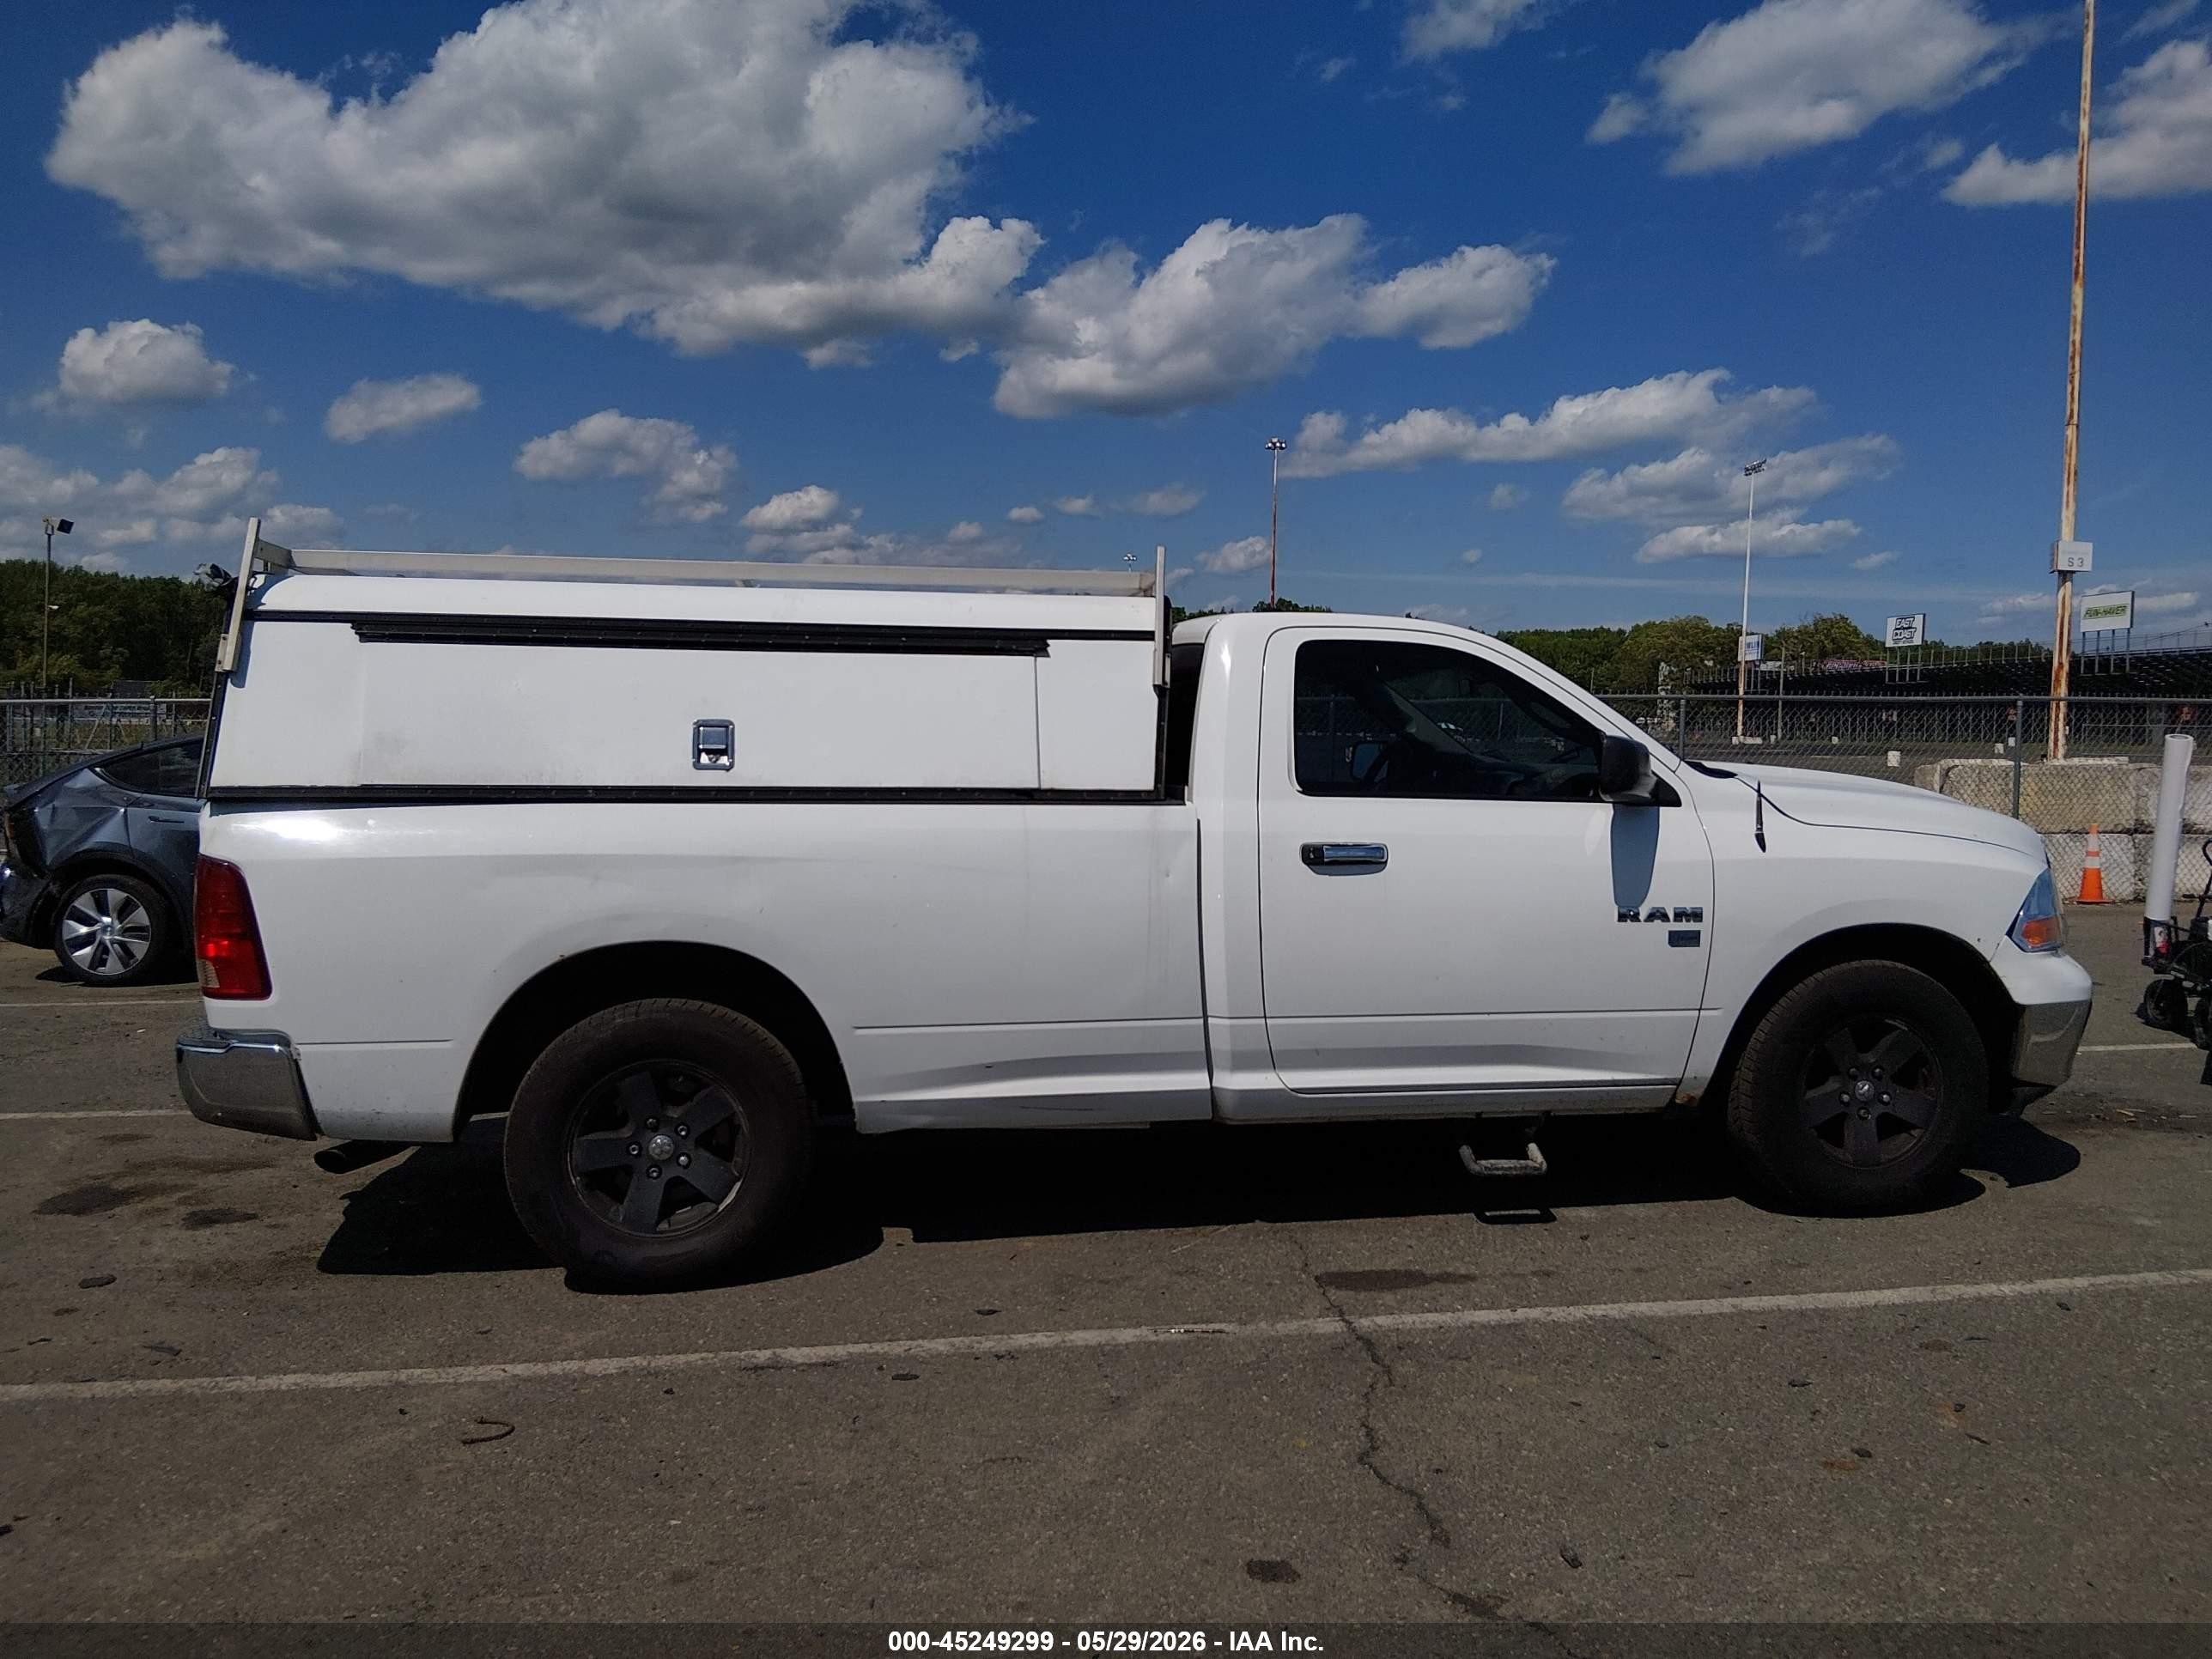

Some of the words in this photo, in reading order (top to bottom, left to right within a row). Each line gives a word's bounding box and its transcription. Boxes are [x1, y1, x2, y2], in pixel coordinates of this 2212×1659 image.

[2068, 556, 2075, 568] S
[1895, 617, 1915, 628] EAST
[1892, 627, 1917, 640] COAST
[1617, 907, 1704, 922] RAM
